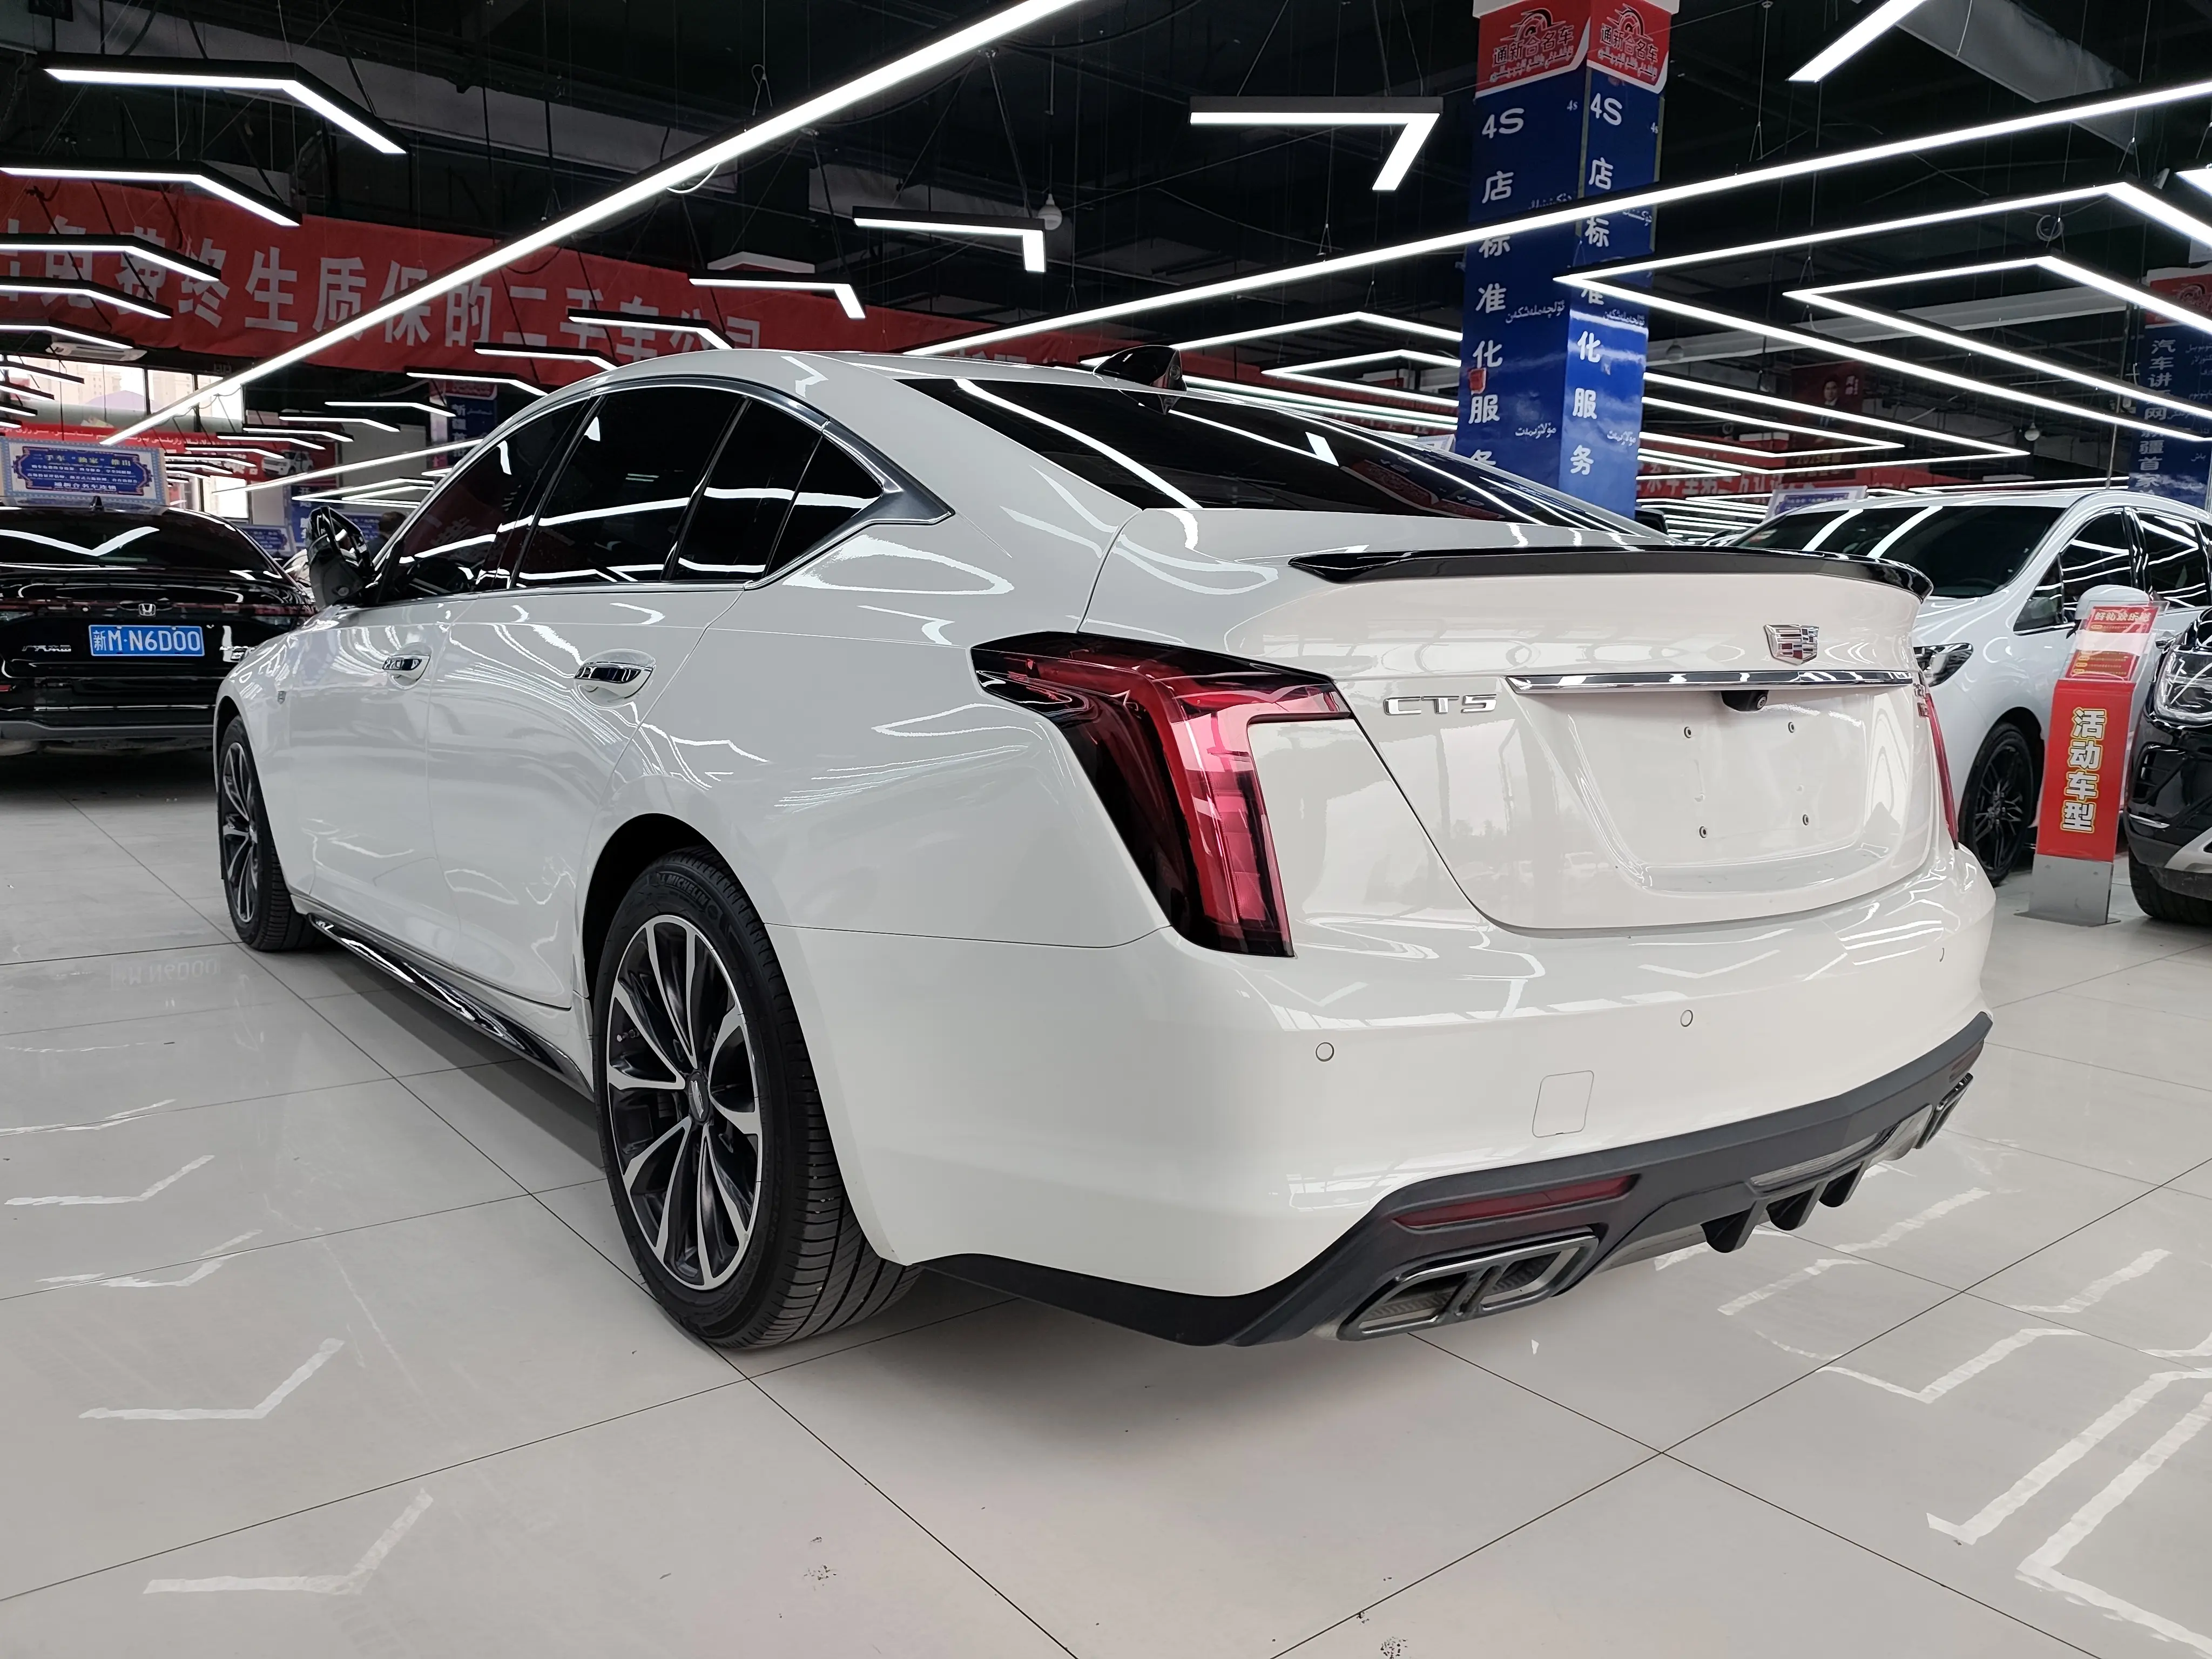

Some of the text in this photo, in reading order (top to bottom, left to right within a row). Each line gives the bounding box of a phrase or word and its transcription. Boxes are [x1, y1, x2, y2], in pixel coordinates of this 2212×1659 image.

[1492, 25, 1574, 68] 通新合名车
[1600, 23, 1658, 64] 通新合名车
[0, 215, 760, 362] 免费终生质保的二手车公司
[1383, 693, 1497, 716] CT5
[2061, 707, 2108, 833] 活动车型
[667, 874, 711, 907] MICHELIN
